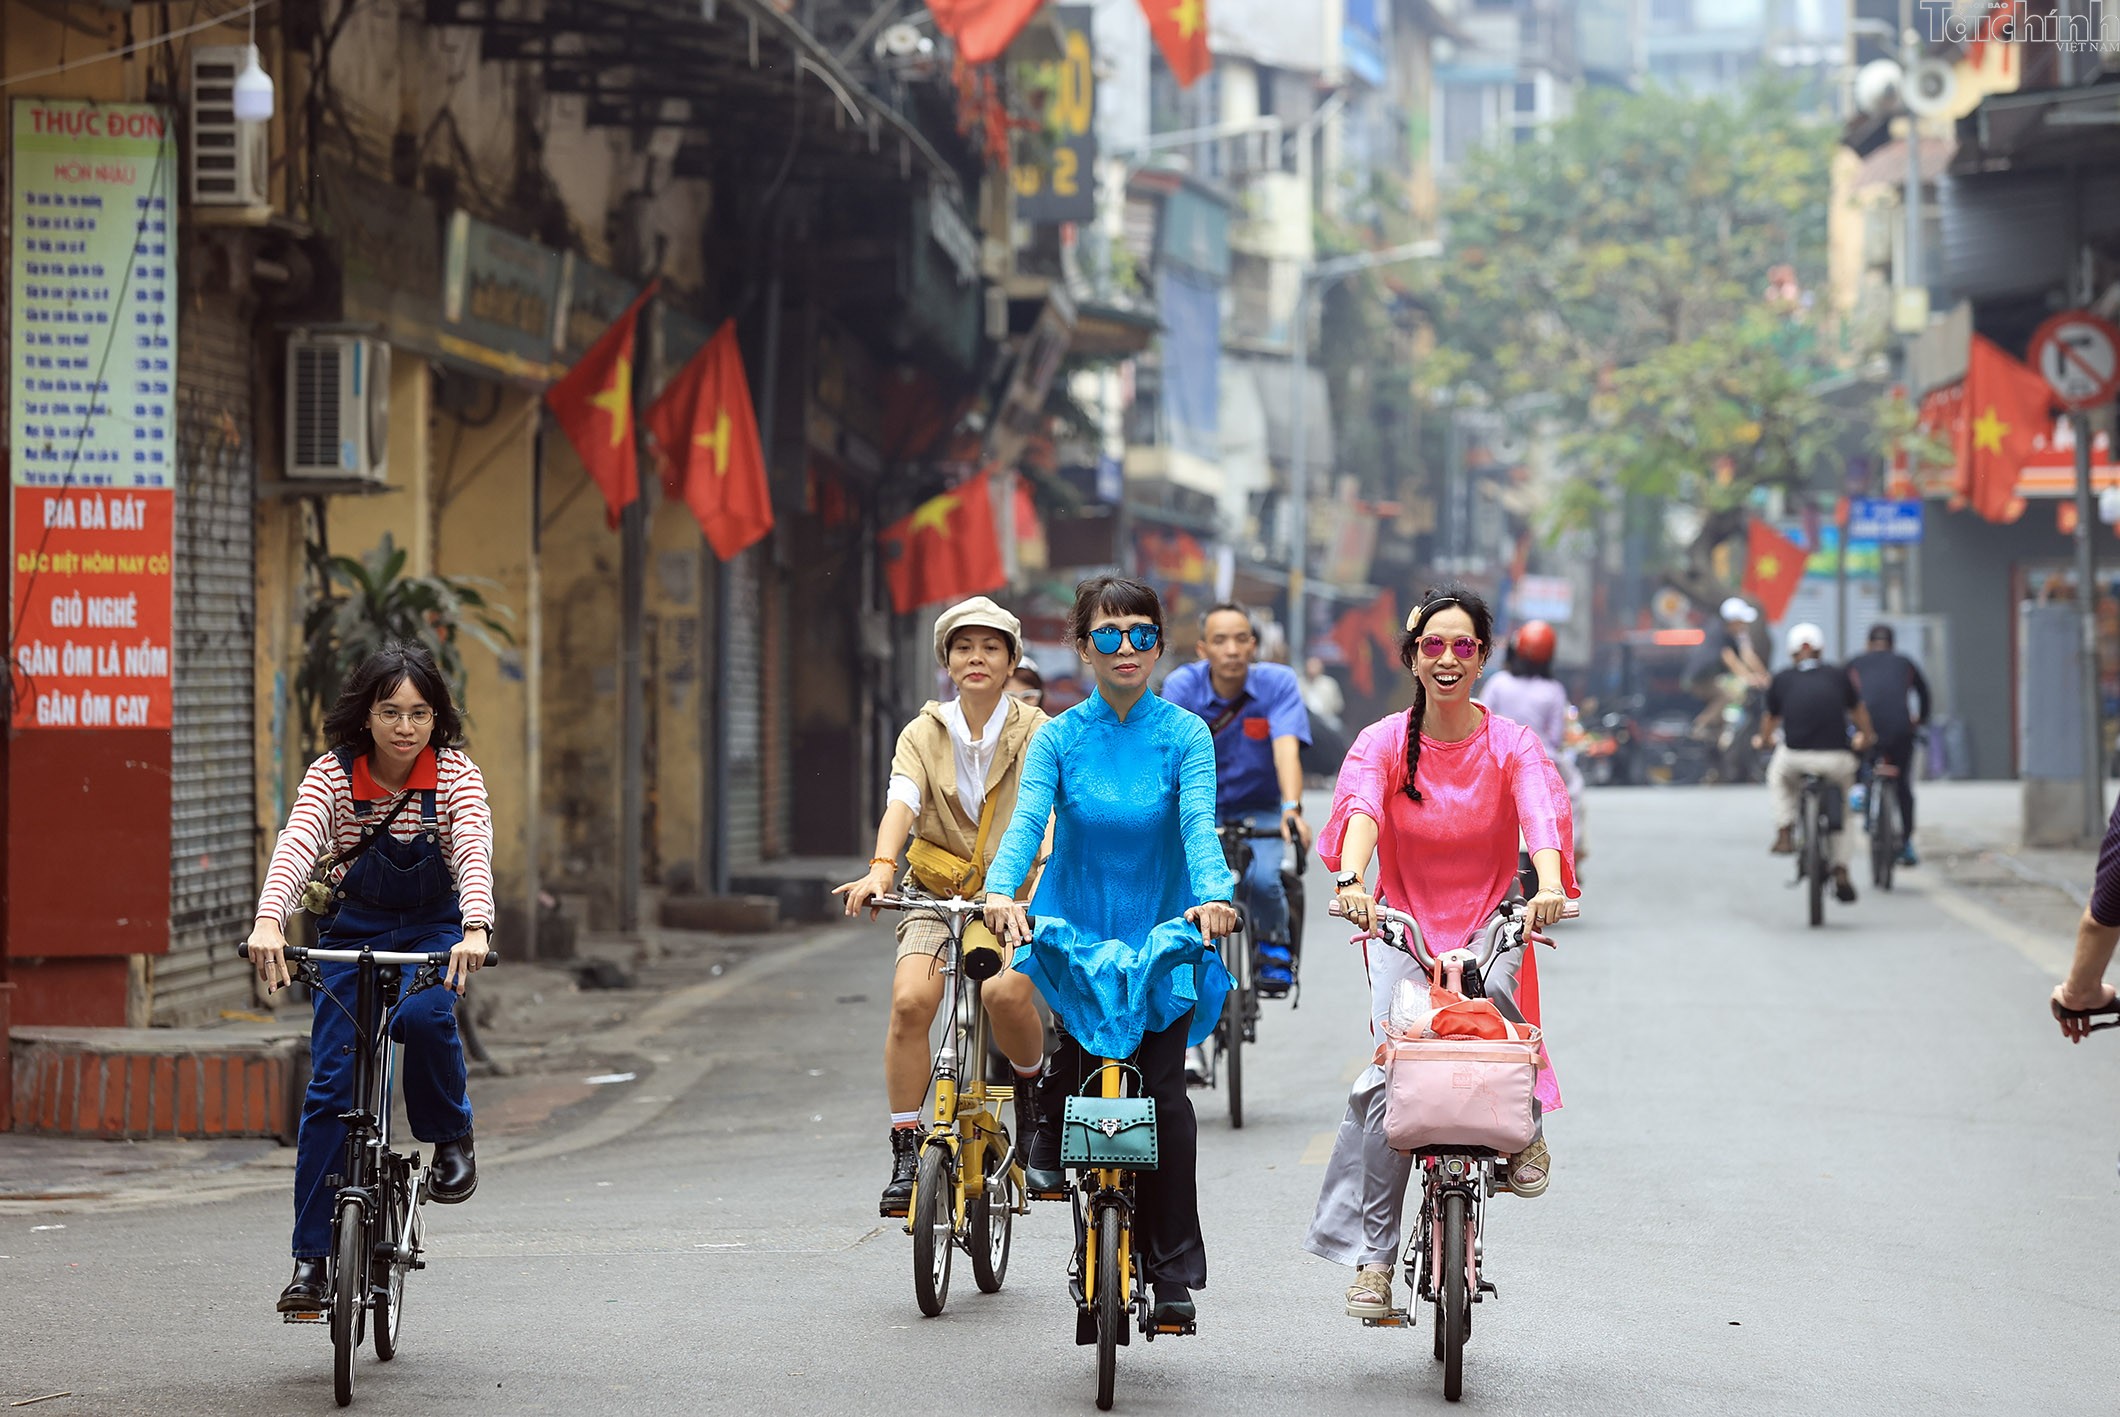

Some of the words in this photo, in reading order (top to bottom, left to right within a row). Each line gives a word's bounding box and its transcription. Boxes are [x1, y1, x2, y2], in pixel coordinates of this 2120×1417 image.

[31, 107, 101, 140] THỰC
[106, 111, 165, 139] ĐƠN
[43, 496, 76, 529] BIA
[80, 491, 106, 530] BÀ
[110, 491, 147, 531] BÁT
[82, 549, 115, 575] HÔM
[117, 553, 145, 575] NAY
[87, 590, 138, 628] NGHÉ
[97, 639, 121, 677] LÁ
[116, 693, 150, 727] CAY
